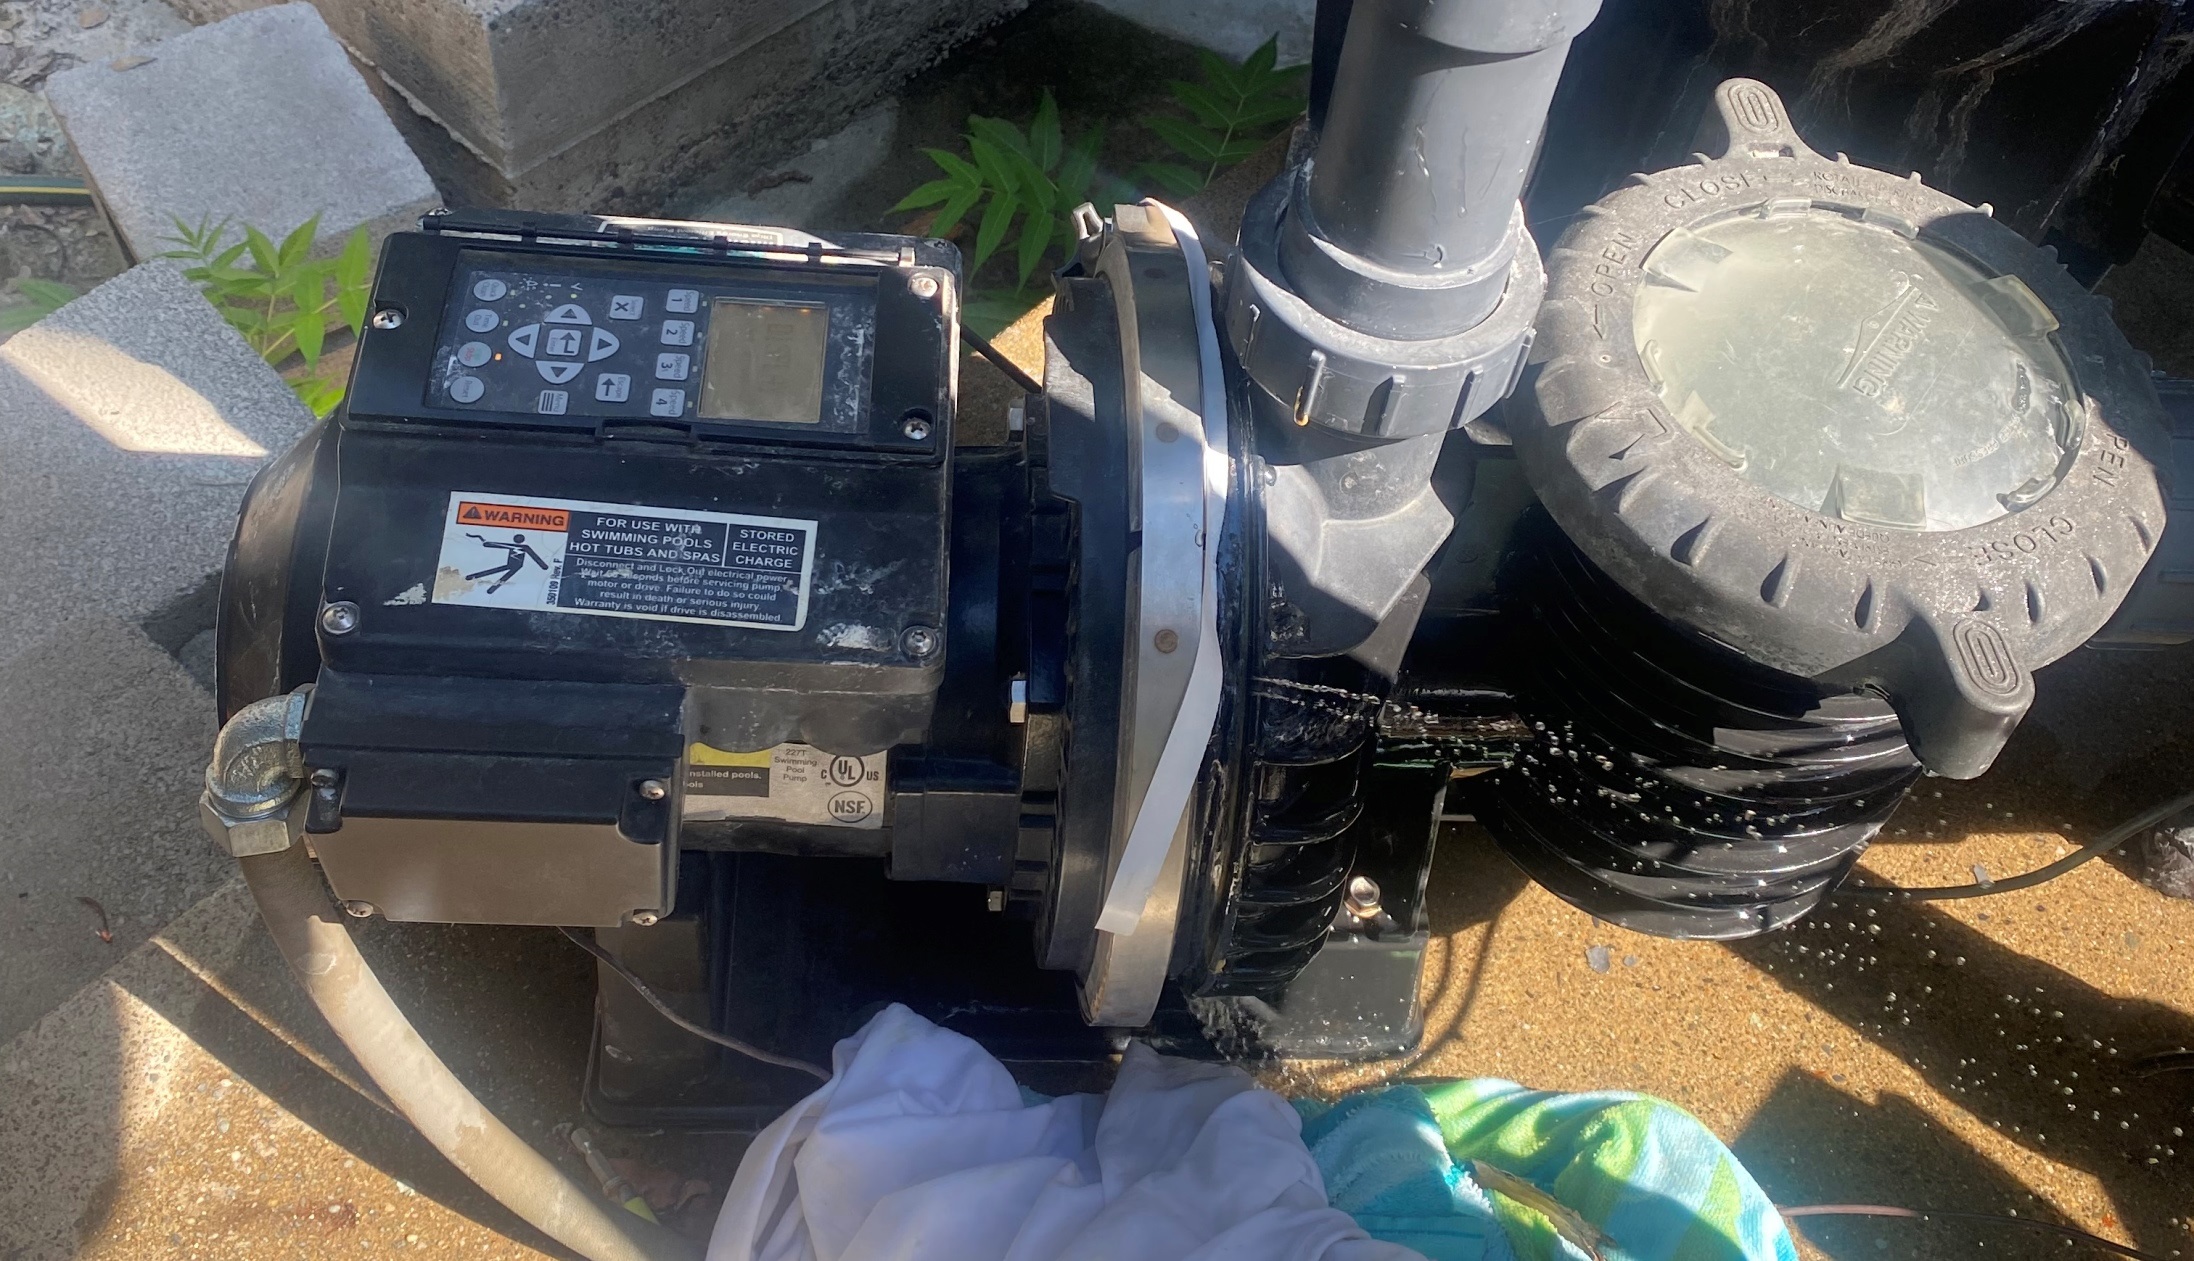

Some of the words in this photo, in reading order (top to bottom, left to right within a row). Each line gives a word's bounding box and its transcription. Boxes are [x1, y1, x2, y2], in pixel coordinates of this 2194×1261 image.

[1591, 232, 1640, 297] OPEN
[683, 291, 695, 312] Speed
[678, 322, 691, 344] Speed
[1853, 310, 1932, 398] WARNING
[673, 355, 686, 379] Speed
[615, 376, 626, 399] Escape
[552, 393, 564, 412] Menu
[668, 390, 681, 416] Speed
[2093, 433, 2128, 487] PEN
[484, 510, 565, 526] WARNING
[596, 517, 627, 529] FOR
[631, 520, 660, 531] USE
[665, 522, 702, 534] WITH
[581, 529, 658, 544] SWIMMING
[662, 535, 713, 549] POOLS
[740, 529, 795, 542] STORED
[569, 541, 600, 553] HOT
[604, 544, 643, 557] TUBS
[647, 548, 678, 559] AND
[682, 551, 720, 563] SPAS
[732, 541, 799, 556] ELECTRIC
[576, 557, 635, 570] Disconnect
[637, 563, 657, 572] and
[659, 565, 684, 574] Lock
[707, 568, 754, 580] electrical
[735, 555, 793, 568] CHARGE
[546, 580, 559, 605] 350109
[588, 579, 618, 588] motor
[621, 582, 632, 590] or
[666, 584, 701, 595] Failure
[704, 588, 714, 596] to
[717, 588, 730, 598] do
[733, 591, 745, 599] so
[748, 591, 777, 601] could
[667, 574, 700, 585] before
[702, 578, 749, 591] servicing
[600, 590, 629, 600] result
[632, 592, 642, 600] in
[644, 593, 674, 604] death
[690, 598, 728, 608] serious
[574, 597, 621, 611] Warranty
[623, 601, 633, 610] is
[635, 603, 658, 612] void
[660, 604, 669, 613] if
[670, 605, 696, 616] drive
[699, 607, 708, 616] is
[710, 608, 783, 622] disassembled.
[774, 756, 818, 767] Swimming
[785, 748, 806, 756] 227T
[689, 770, 729, 778] nstalled
[731, 771, 762, 780] pools.
[783, 773, 808, 783] Pump
[785, 766, 805, 774] Pool
[838, 759, 856, 780] UL
[866, 771, 880, 781] US
[834, 800, 866, 814] NSF
